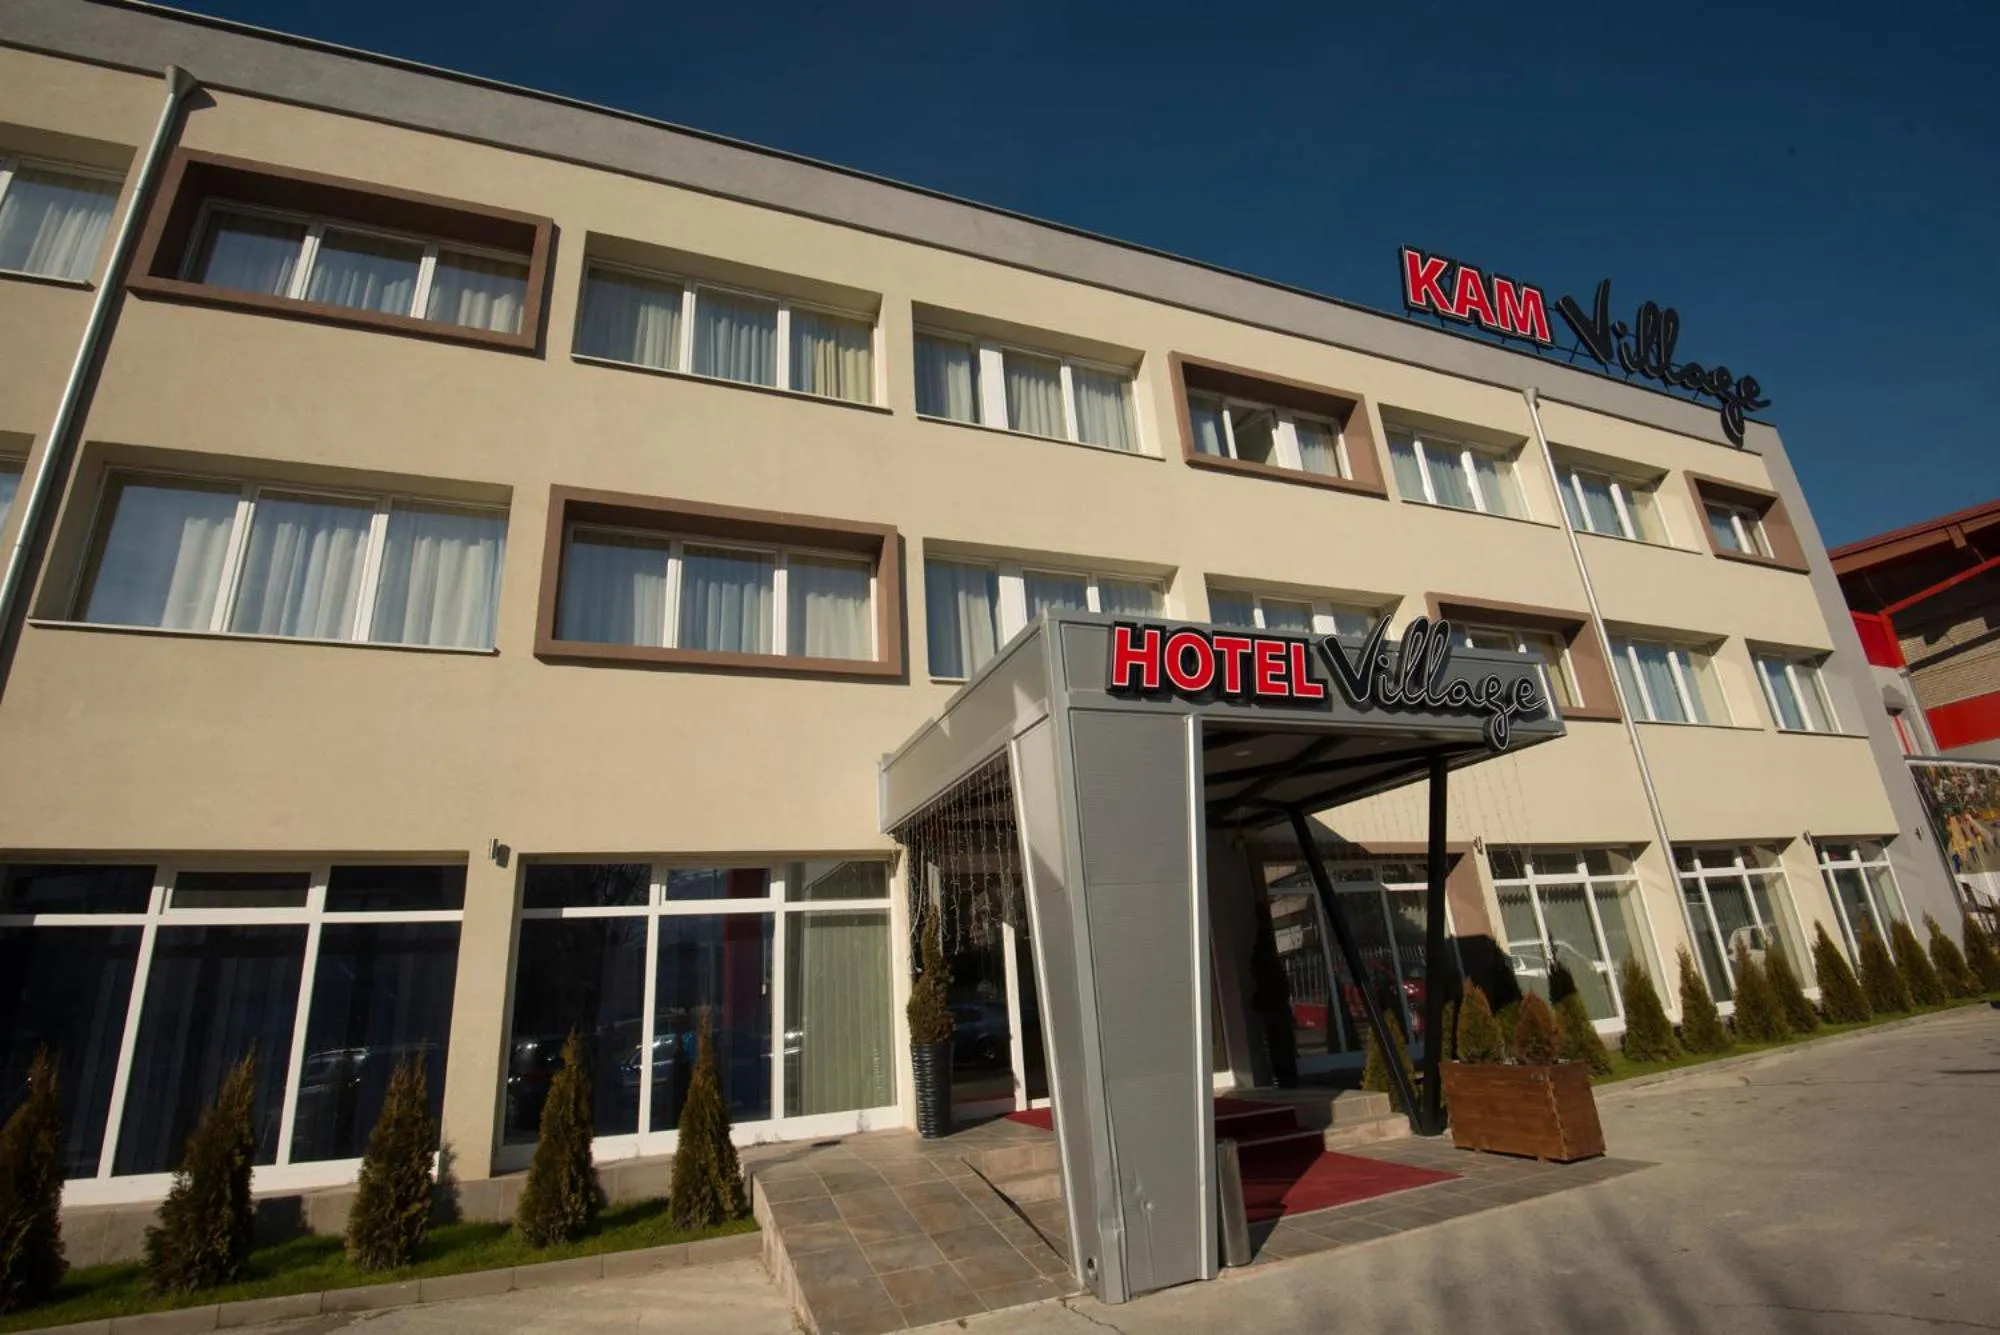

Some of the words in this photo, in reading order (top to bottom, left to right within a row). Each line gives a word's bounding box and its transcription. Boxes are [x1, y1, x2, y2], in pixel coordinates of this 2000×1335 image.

[1404, 250, 1551, 343] KAM
[1555, 279, 1772, 448] Village
[1111, 626, 1324, 698] HOTEL
[1317, 614, 1548, 750] Village
